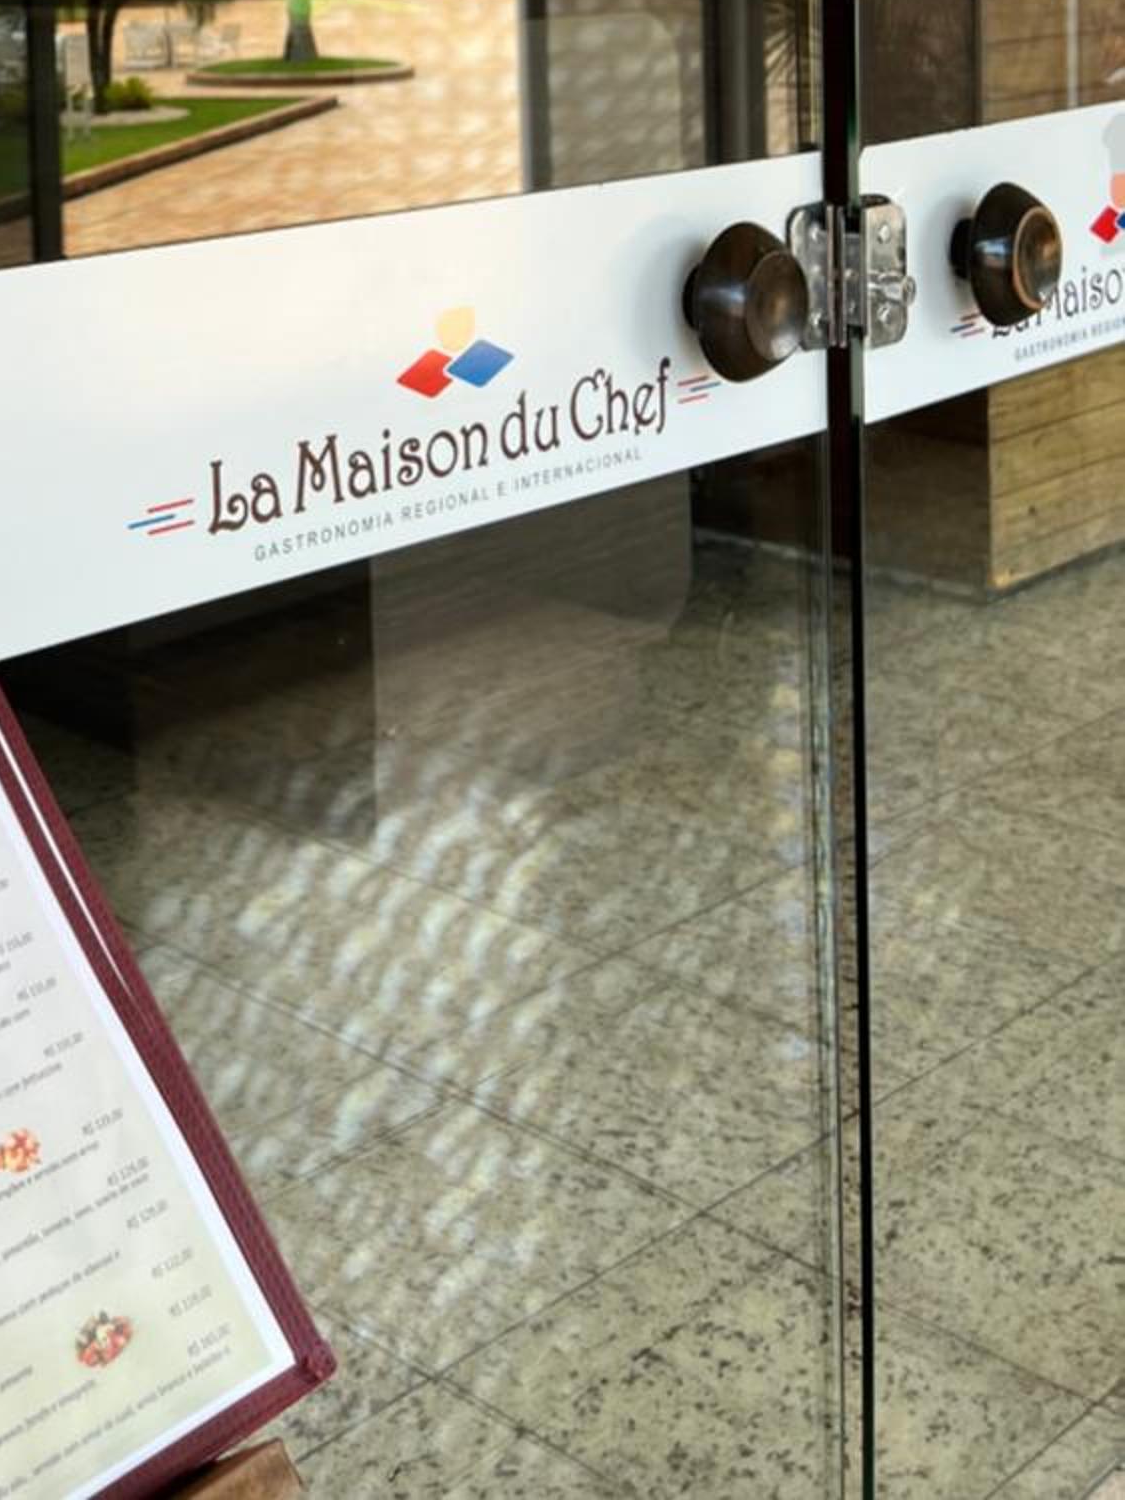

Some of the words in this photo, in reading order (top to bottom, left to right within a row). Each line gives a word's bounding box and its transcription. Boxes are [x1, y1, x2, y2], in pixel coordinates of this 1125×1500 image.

[206, 459, 283, 534] La
[293, 416, 491, 514] Maison
[499, 389, 561, 459] du
[568, 356, 673, 441] Chef
[253, 508, 396, 562] GASTRONOMIA
[400, 486, 491, 521] REGIONAL
[495, 480, 508, 498] E
[512, 448, 644, 493] INTERNACIONAL
